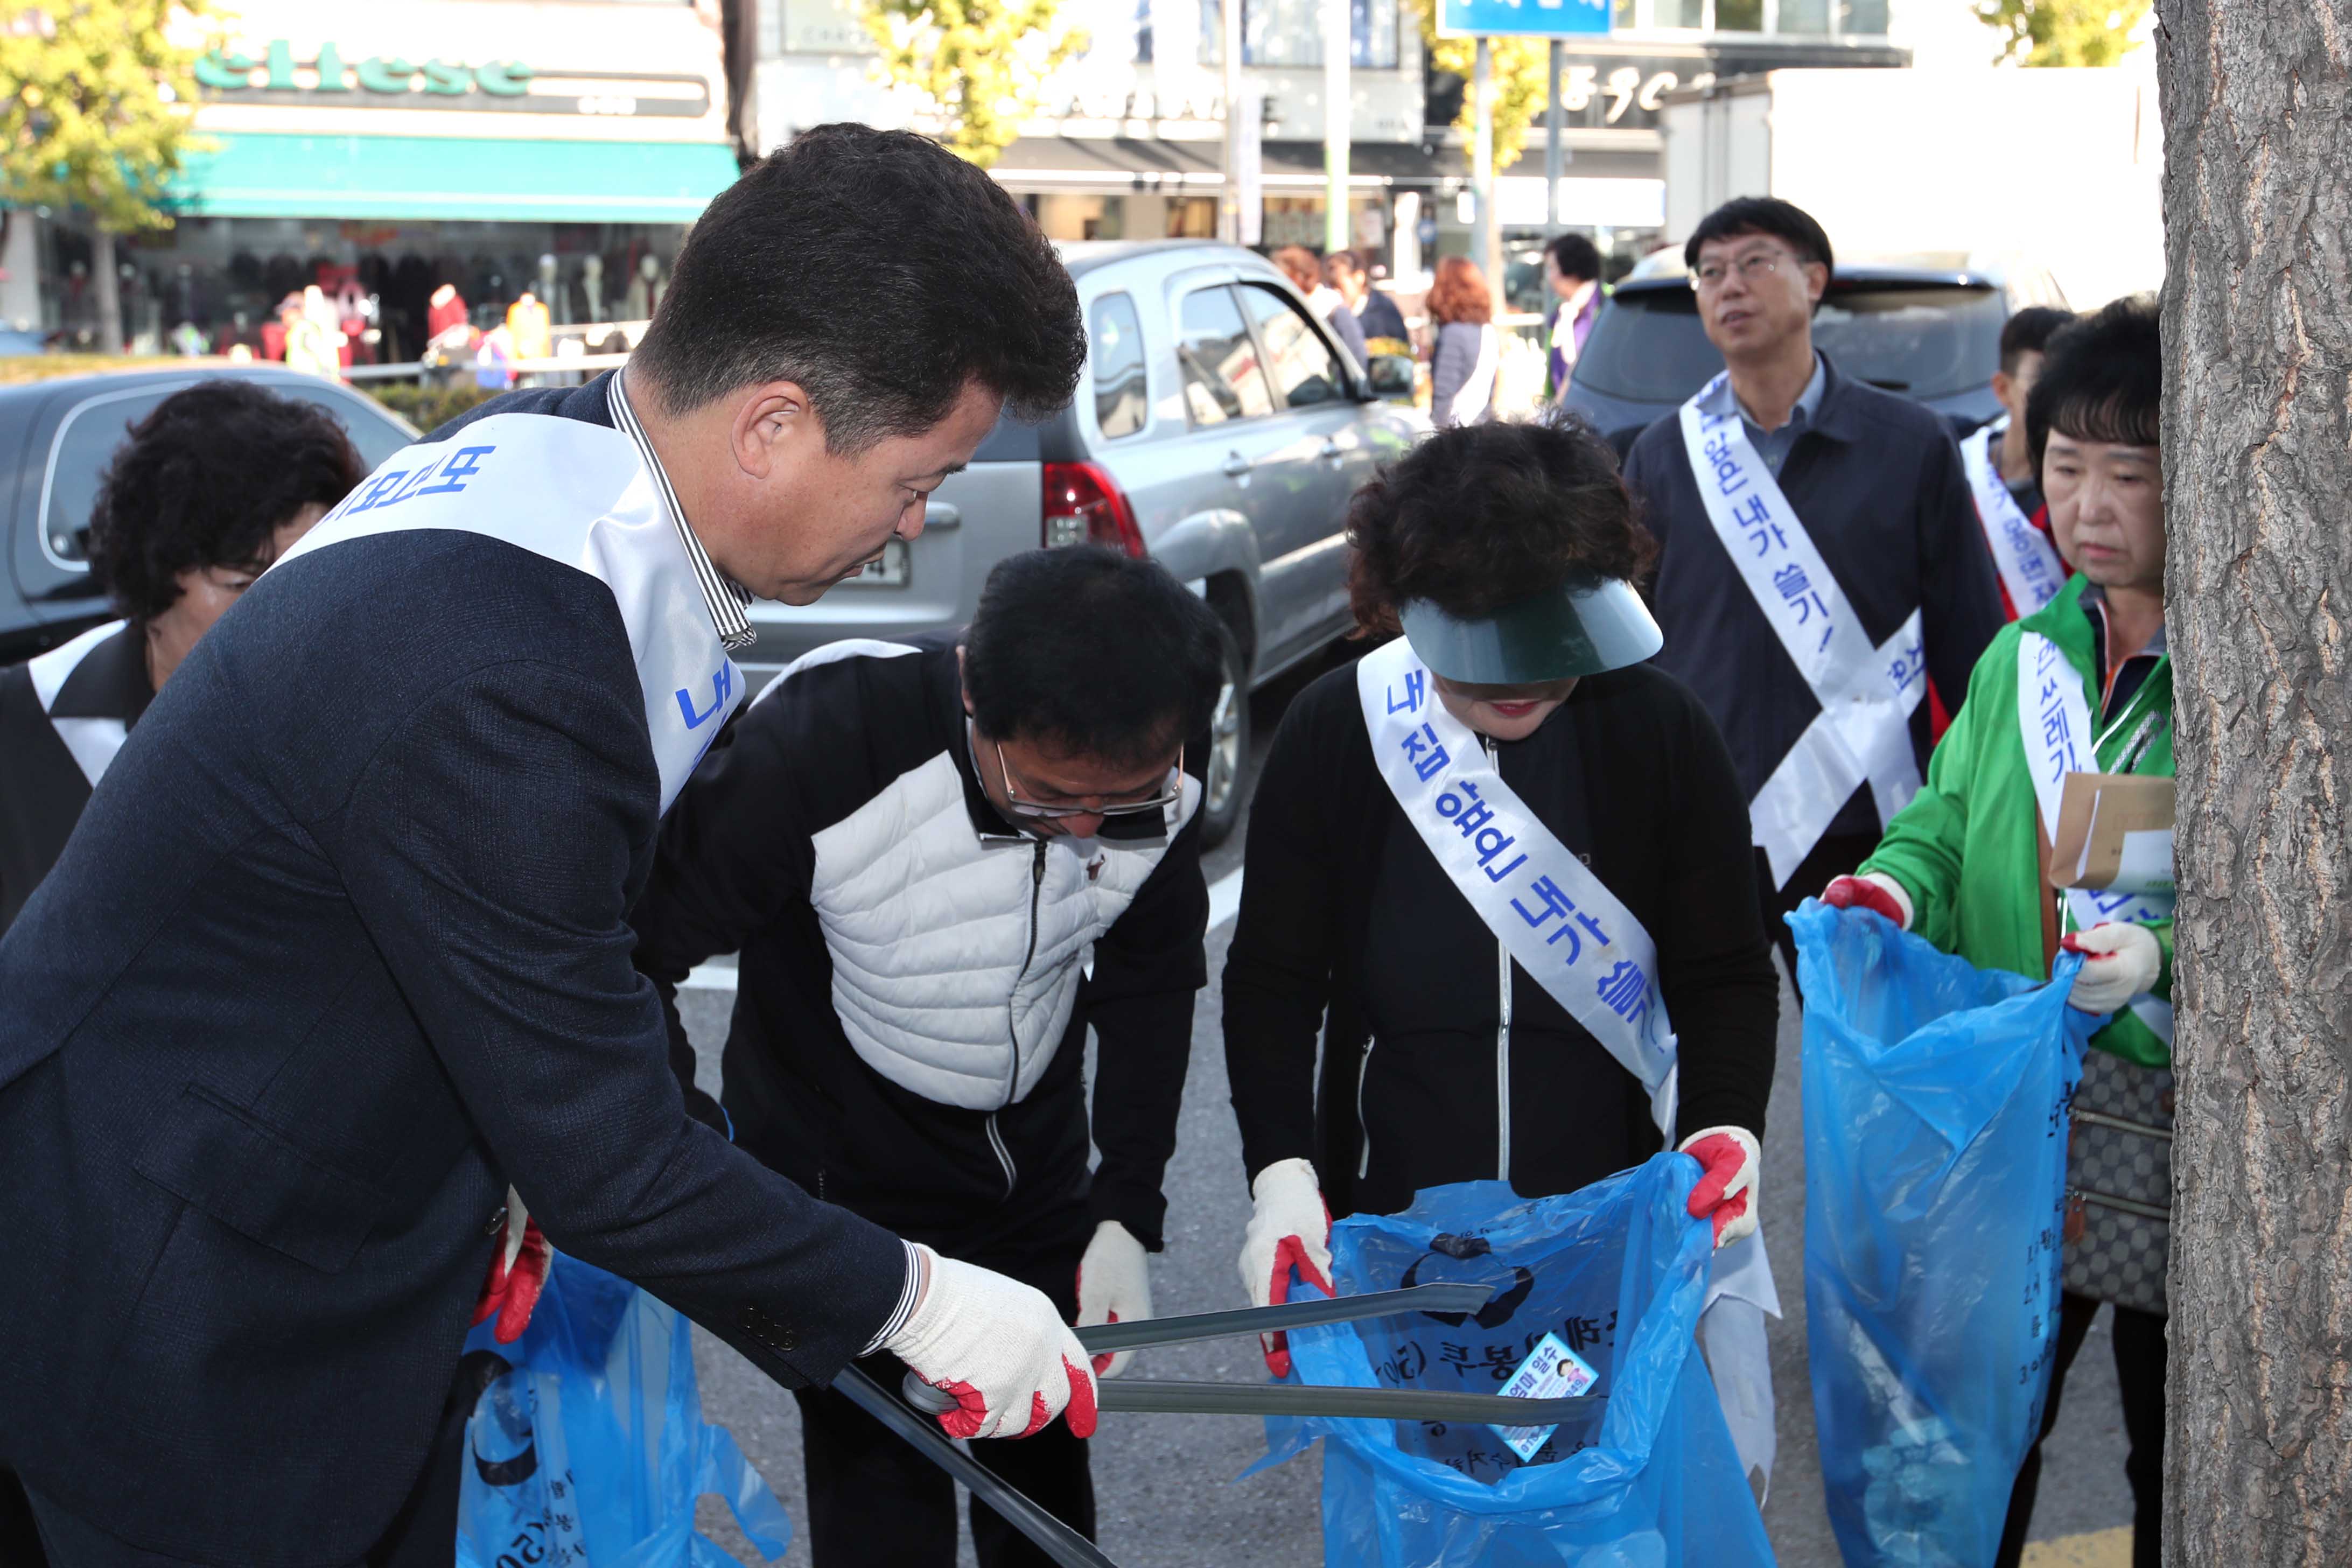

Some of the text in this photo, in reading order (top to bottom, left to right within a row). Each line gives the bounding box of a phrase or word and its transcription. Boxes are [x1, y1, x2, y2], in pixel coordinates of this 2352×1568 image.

[1732, 495, 1787, 557] 내가
[675, 658, 732, 730] 내
[1387, 669, 1424, 716] 내
[1401, 723, 1451, 783] 집
[1436, 780, 1528, 883] 앞은
[1511, 874, 1611, 966] 내가
[1507, 1371, 1538, 1398] 엄마
[1531, 1346, 1558, 1374] 일수
